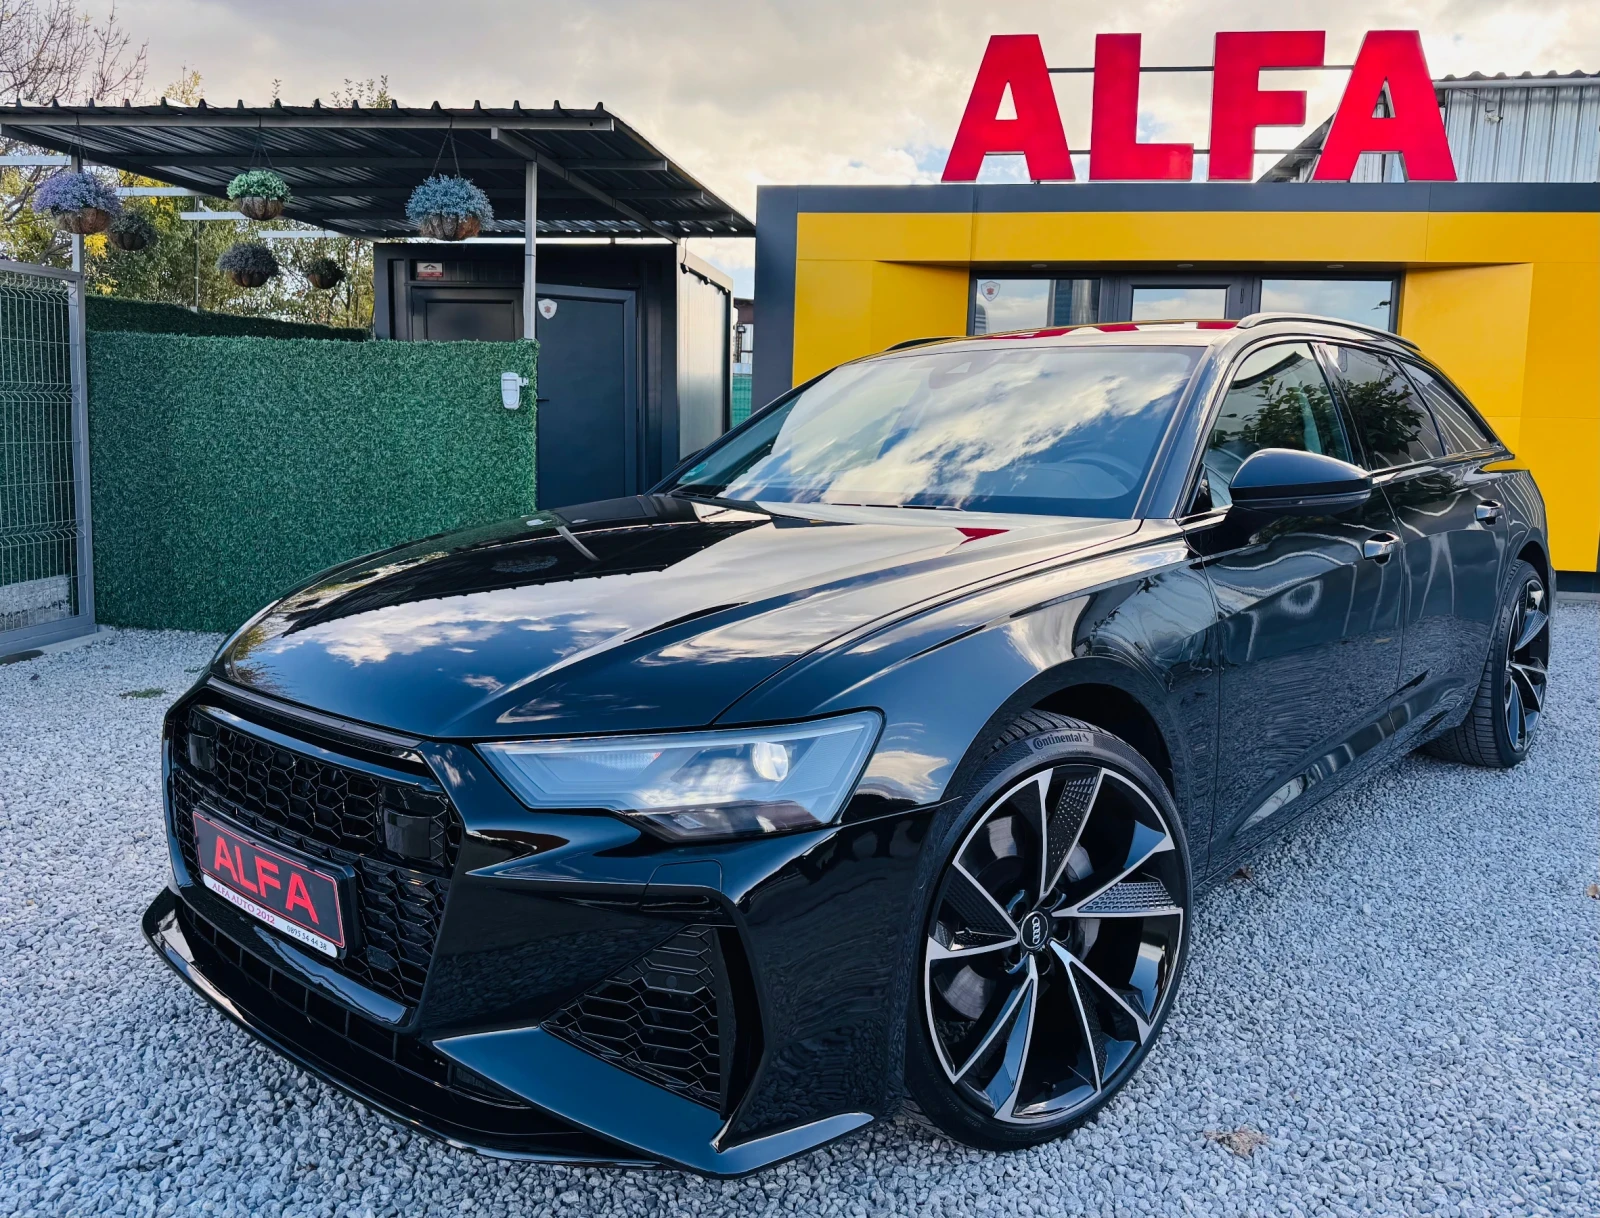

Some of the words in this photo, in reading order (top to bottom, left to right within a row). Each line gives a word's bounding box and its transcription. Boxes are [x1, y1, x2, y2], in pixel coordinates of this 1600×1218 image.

[940, 29, 1458, 183] ALFA
[1032, 732, 1083, 750] Continental
[213, 834, 320, 925] ALFA
[212, 883, 231, 899] ALFA
[231, 895, 255, 914] AUTO
[256, 908, 276, 925] 2012
[319, 941, 328, 951] 38
